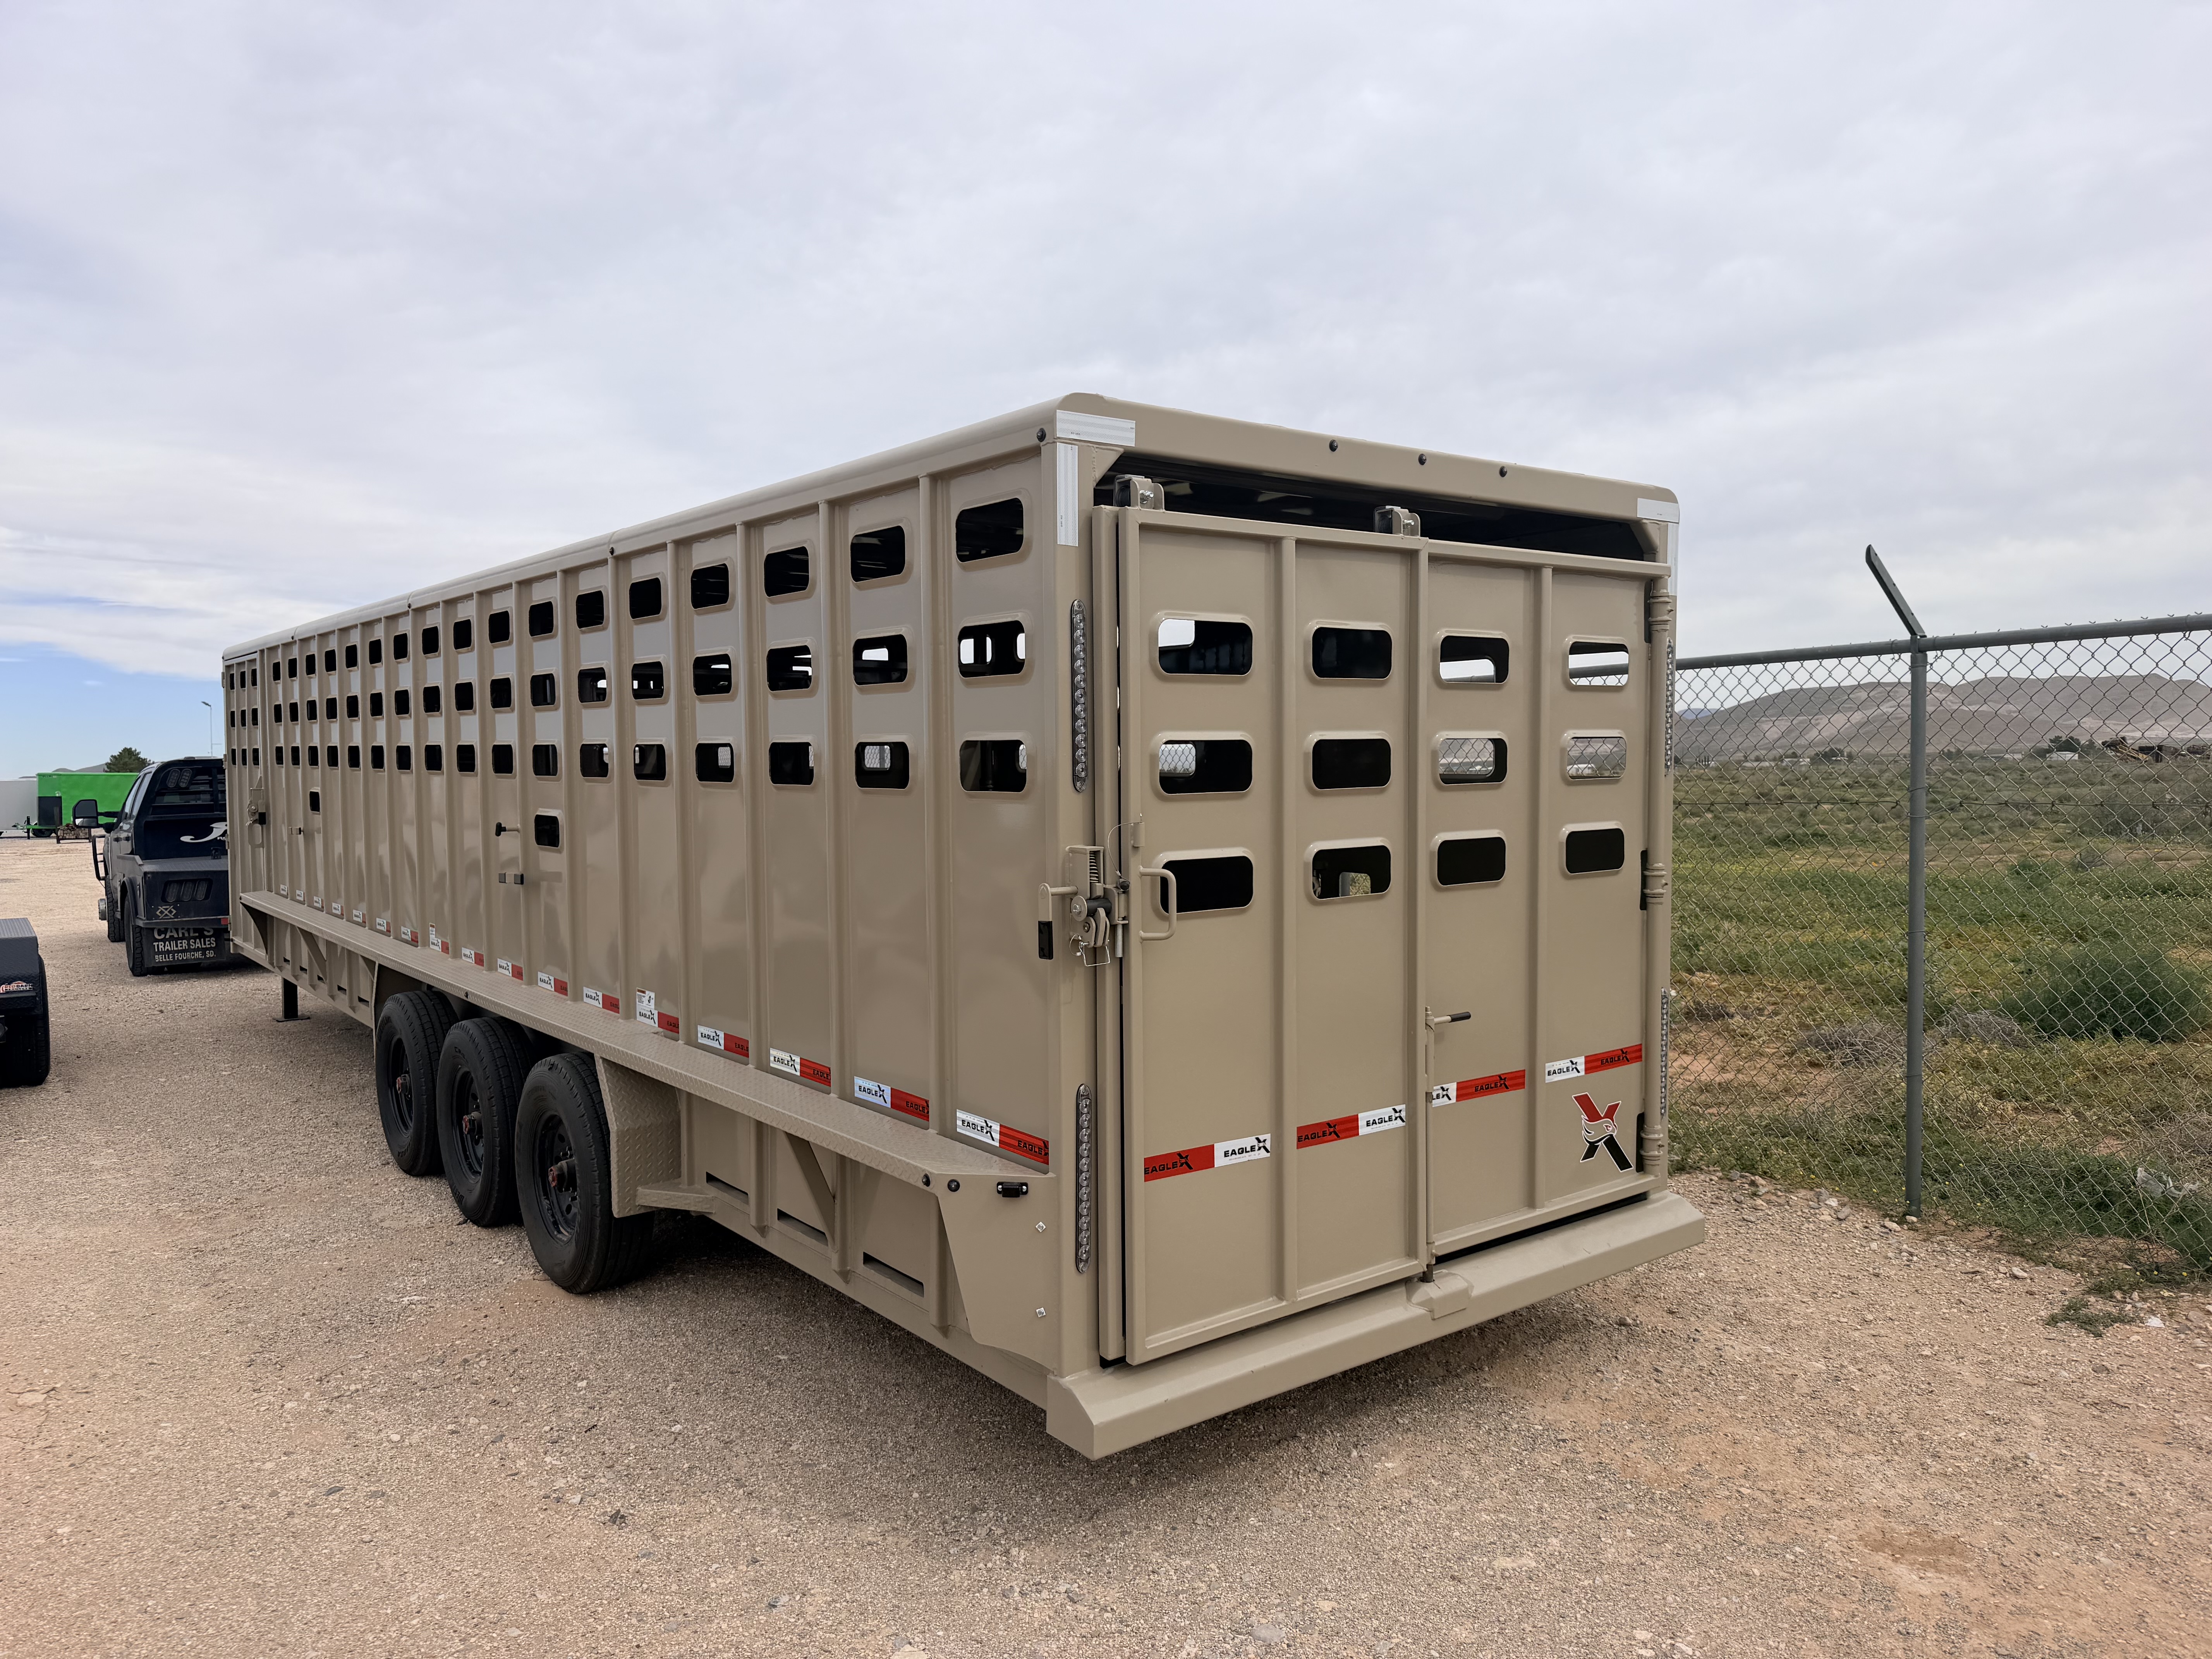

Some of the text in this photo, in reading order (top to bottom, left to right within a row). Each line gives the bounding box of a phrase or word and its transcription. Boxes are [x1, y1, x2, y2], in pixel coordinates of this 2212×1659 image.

[154, 927, 214, 939] CARLS
[153, 938, 216, 951] TRAILER SALES
[175, 951, 204, 960] FOURCHE,
[813, 1067, 831, 1080] EAGLE
